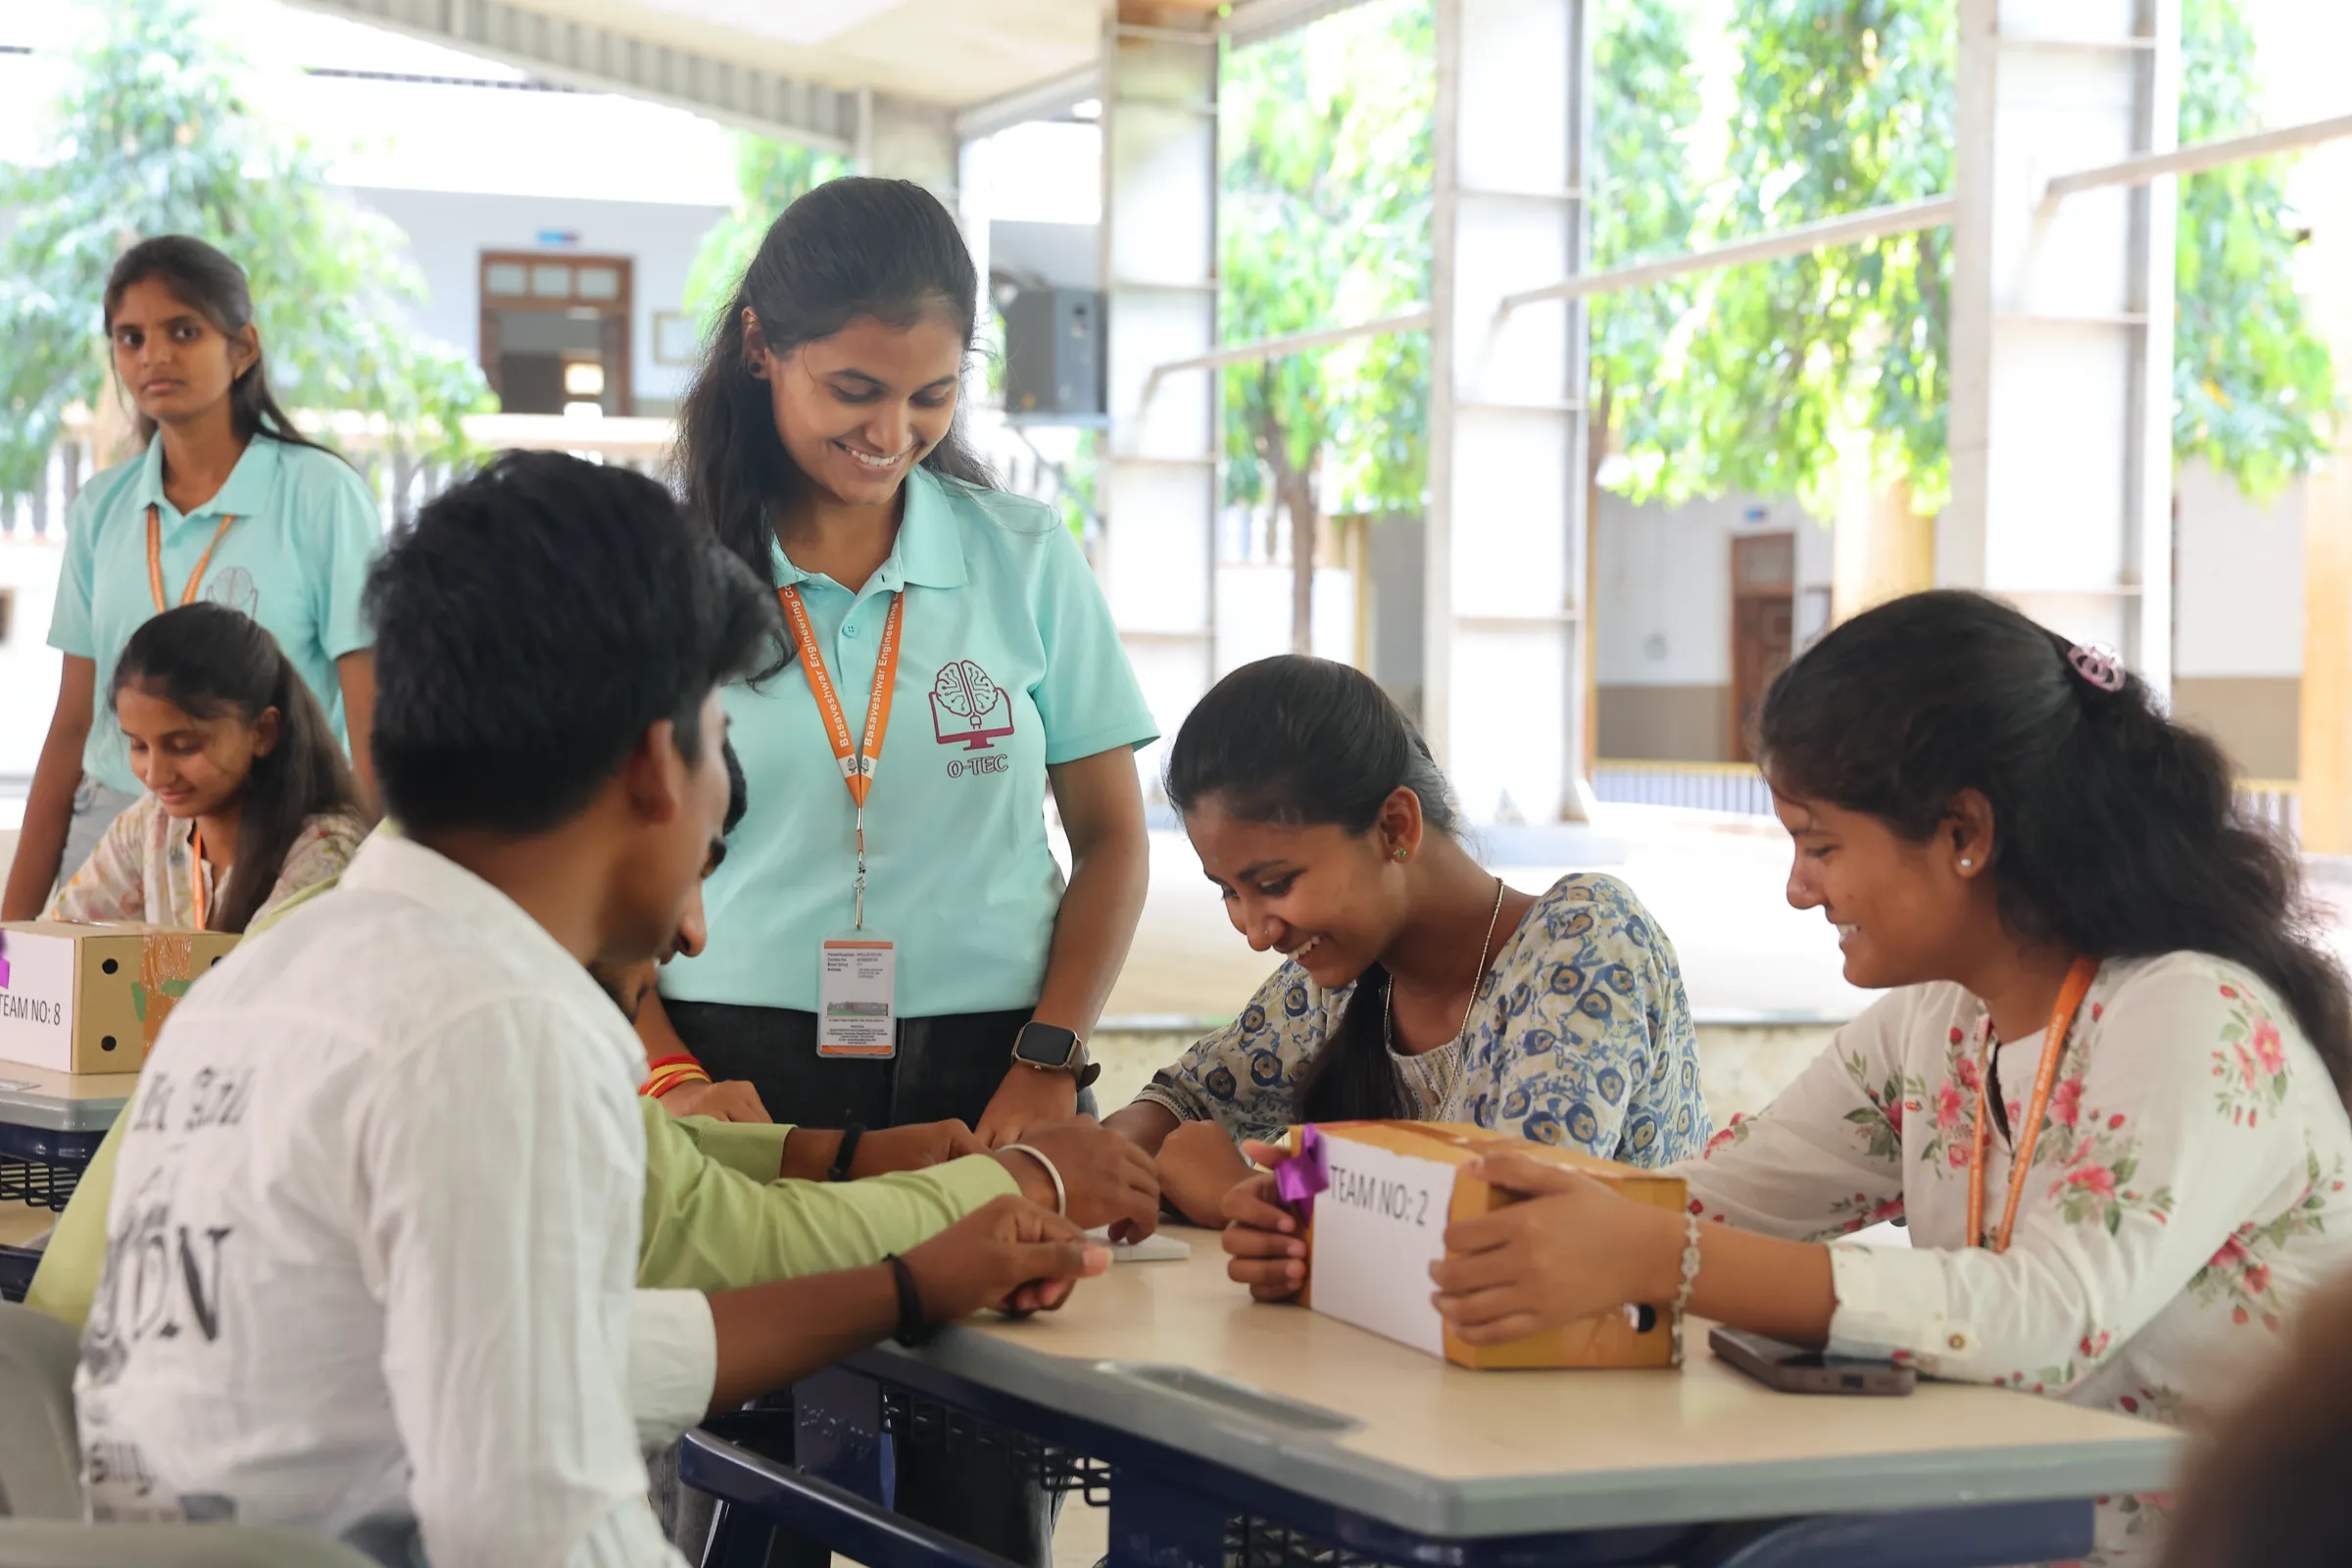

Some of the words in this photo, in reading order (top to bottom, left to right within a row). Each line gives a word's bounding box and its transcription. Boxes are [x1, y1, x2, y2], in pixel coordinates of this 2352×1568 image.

[791, 600, 820, 668] Engineering
[863, 669, 886, 747] Basaveshwar
[878, 603, 899, 666] Engineering
[815, 670, 850, 748] Basaveshwar
[947, 754, 1009, 778] O-TEC
[31, 999, 51, 1024] NO:
[53, 1003, 61, 1026] 8
[1330, 1164, 1376, 1211] TEAM
[1377, 1180, 1413, 1223] NO:
[1415, 1189, 1430, 1228] 2
